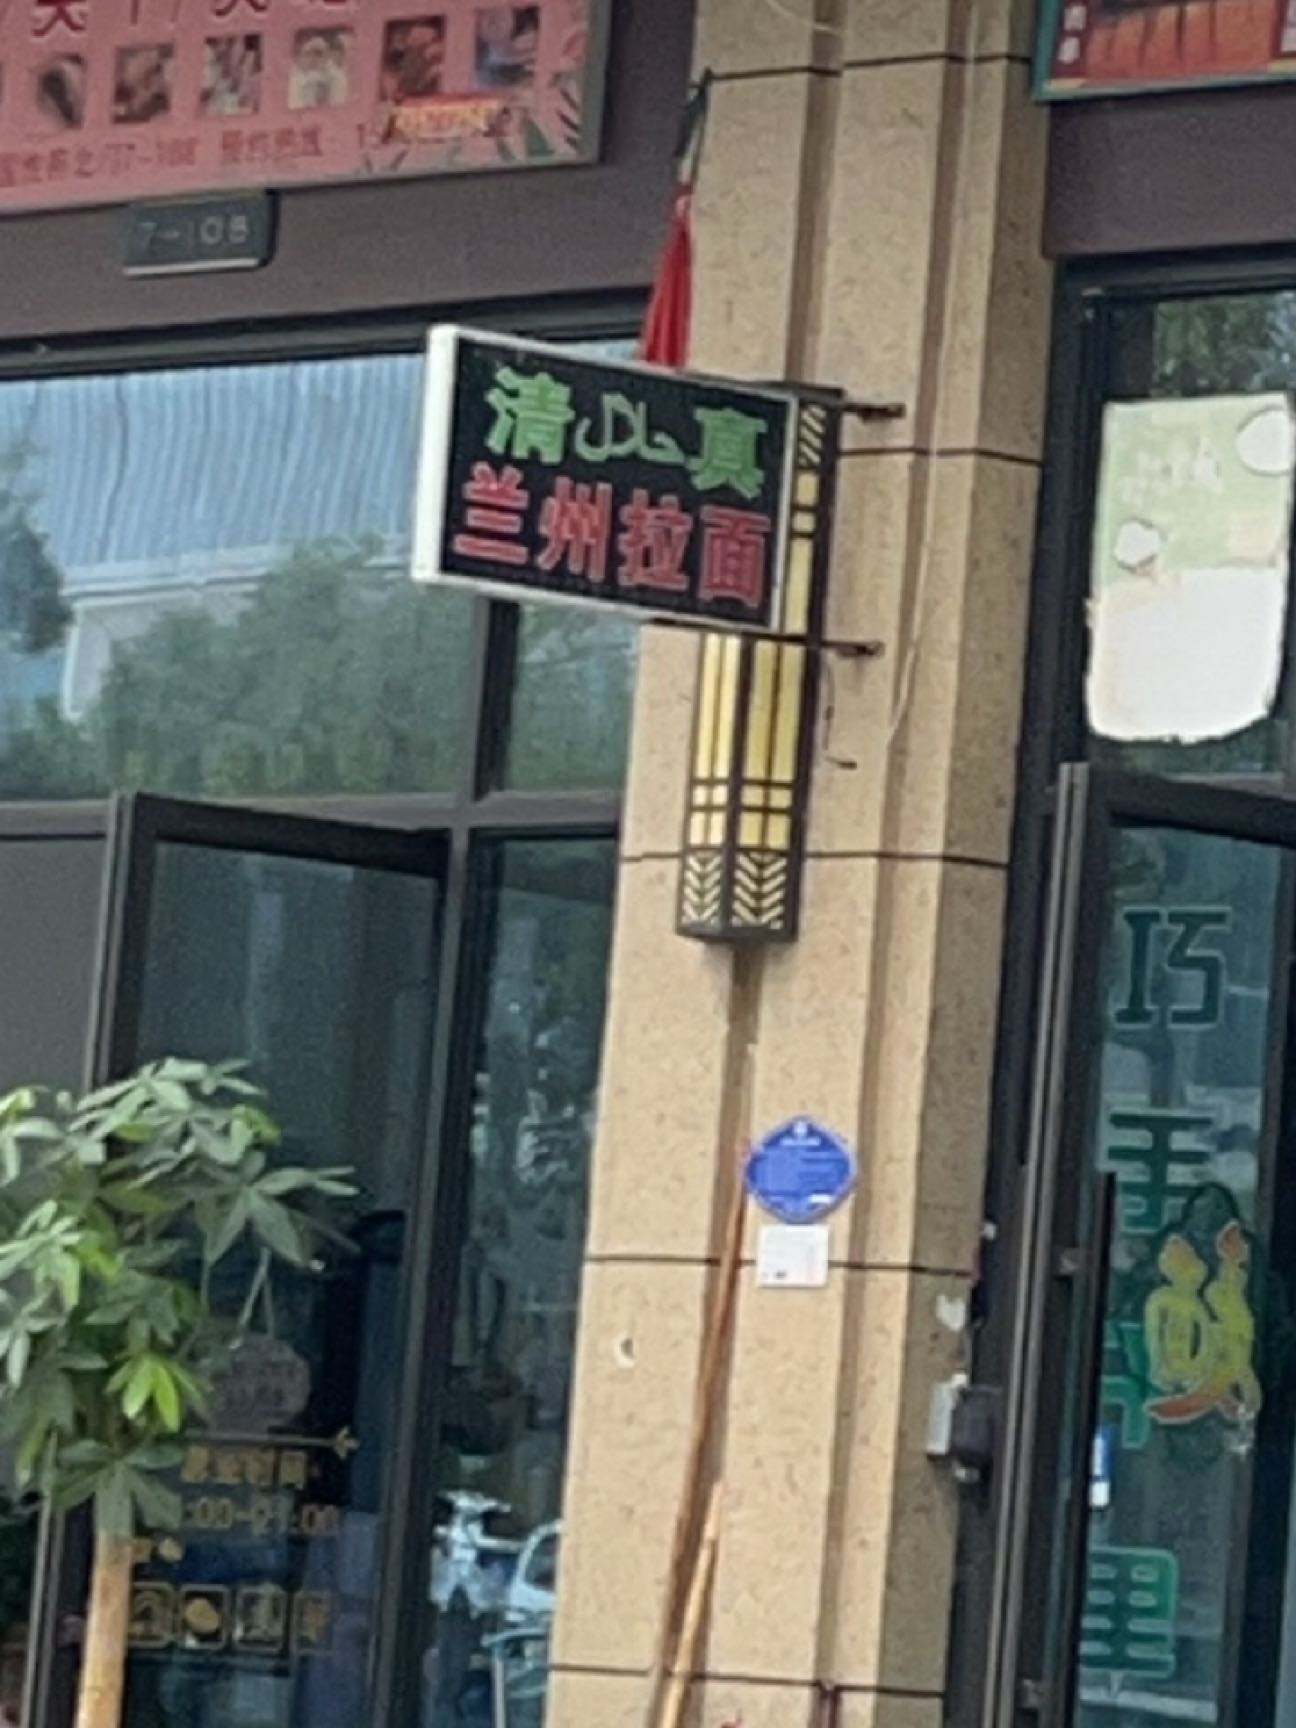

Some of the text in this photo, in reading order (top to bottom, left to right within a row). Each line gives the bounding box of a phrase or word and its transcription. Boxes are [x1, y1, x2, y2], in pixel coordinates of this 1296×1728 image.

[484, 366, 575, 464] 清
[688, 406, 768, 499] 真
[452, 460, 771, 609] 兰州拉面
